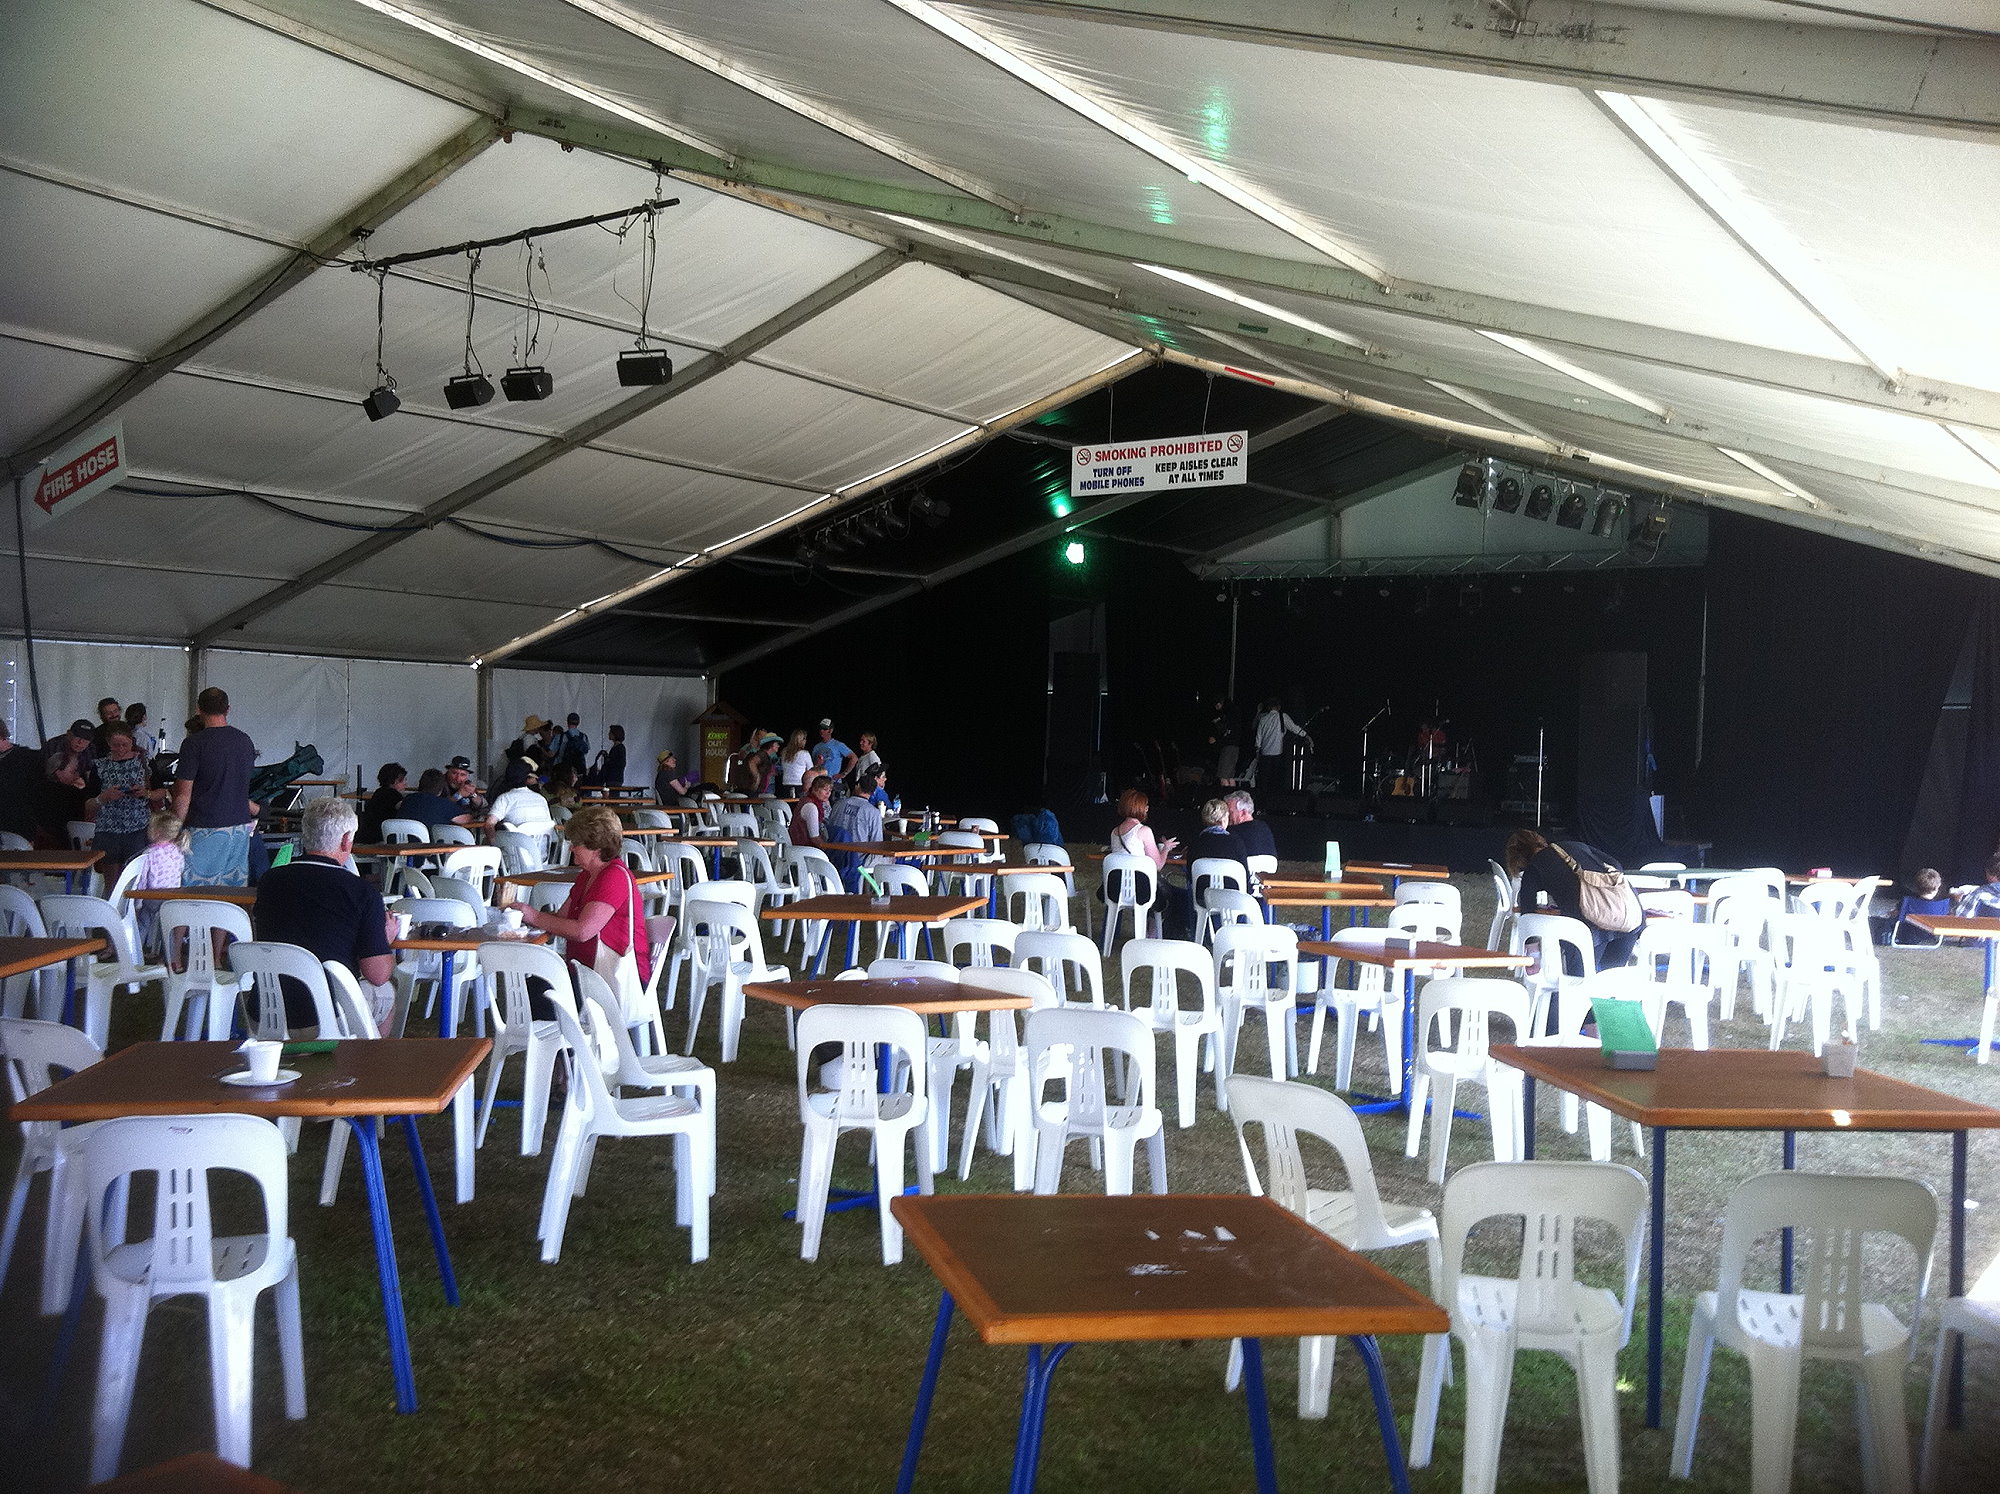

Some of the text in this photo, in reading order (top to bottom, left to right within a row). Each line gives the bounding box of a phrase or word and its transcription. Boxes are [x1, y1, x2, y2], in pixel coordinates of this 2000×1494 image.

[1095, 440, 1223, 462] SMOKING PROHIBITED
[1093, 466, 1132, 478] TURN OFF
[1155, 457, 1238, 473] KEEP AISLES CLEAR
[43, 444, 116, 503] FIRE HOSE
[1168, 470, 1224, 484] AT ALL TIMES
[1080, 477, 1145, 490] MOBILE PHONES
